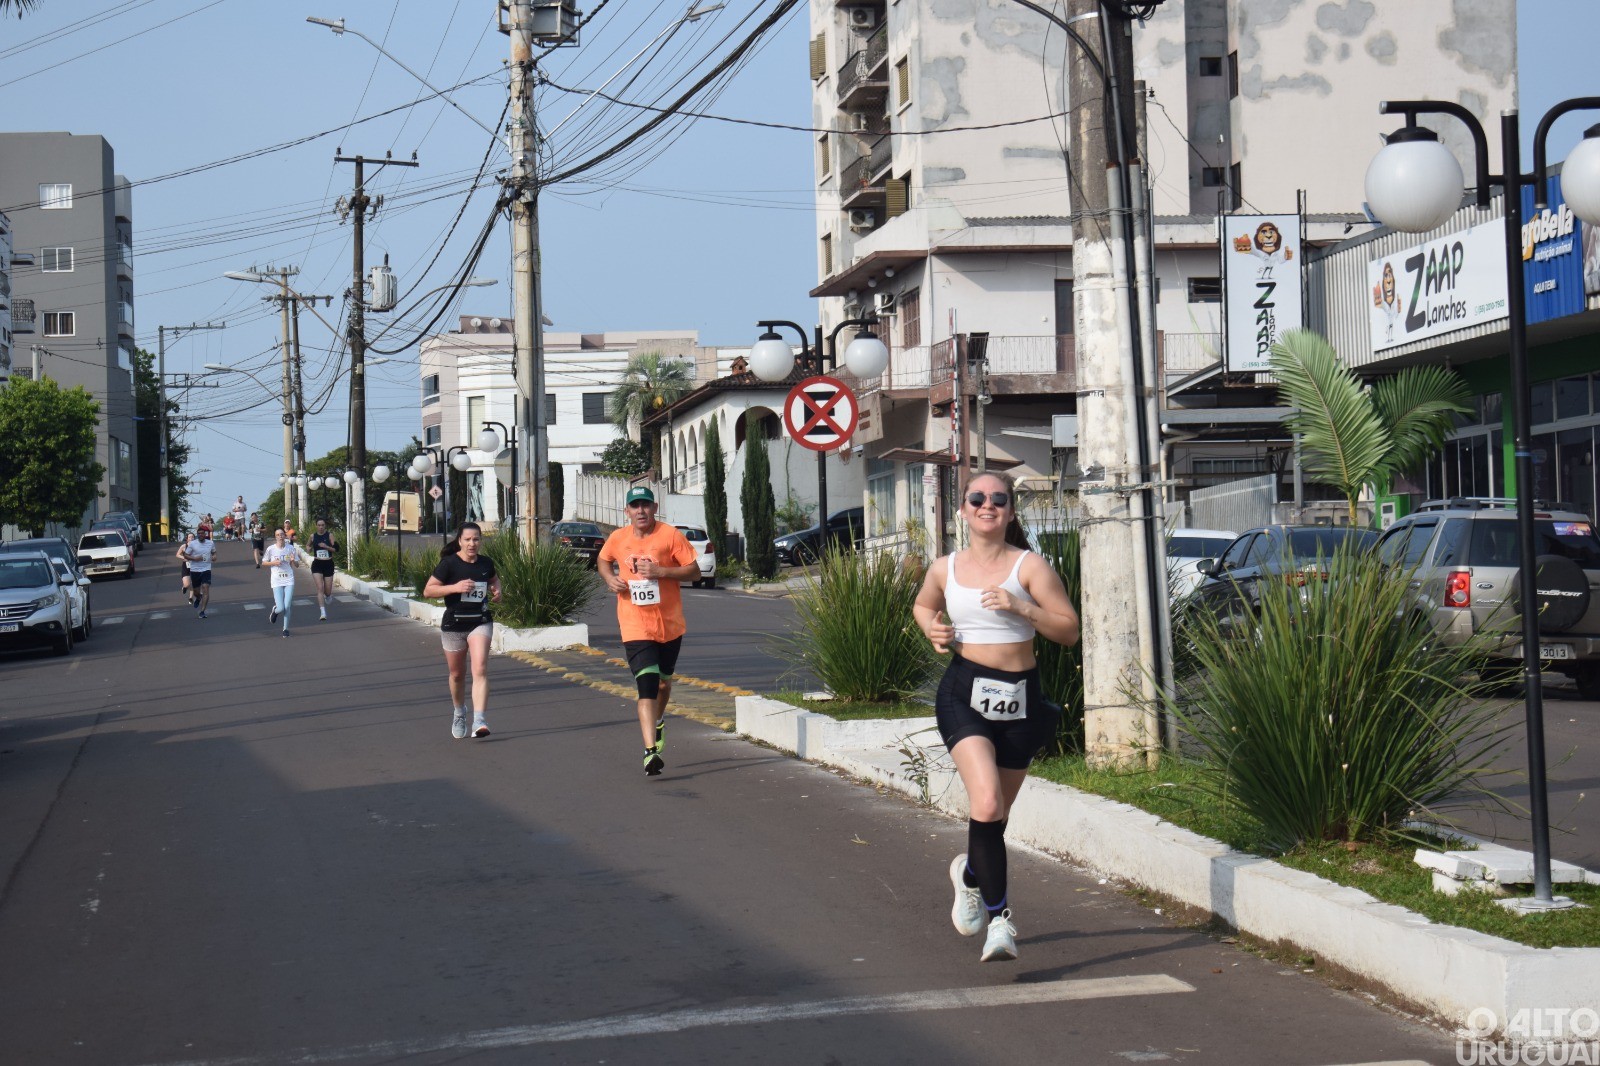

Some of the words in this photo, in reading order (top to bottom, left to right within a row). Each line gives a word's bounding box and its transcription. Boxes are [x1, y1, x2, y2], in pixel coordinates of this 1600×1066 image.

[1555, 238, 1573, 256] animal
[1405, 241, 1464, 333] ZAAP
[1253, 282, 1277, 358] ZAAP
[1426, 295, 1467, 328] Lanches
[466, 590, 484, 599] 143
[632, 590, 655, 601] 105
[980, 698, 1020, 715] 140
